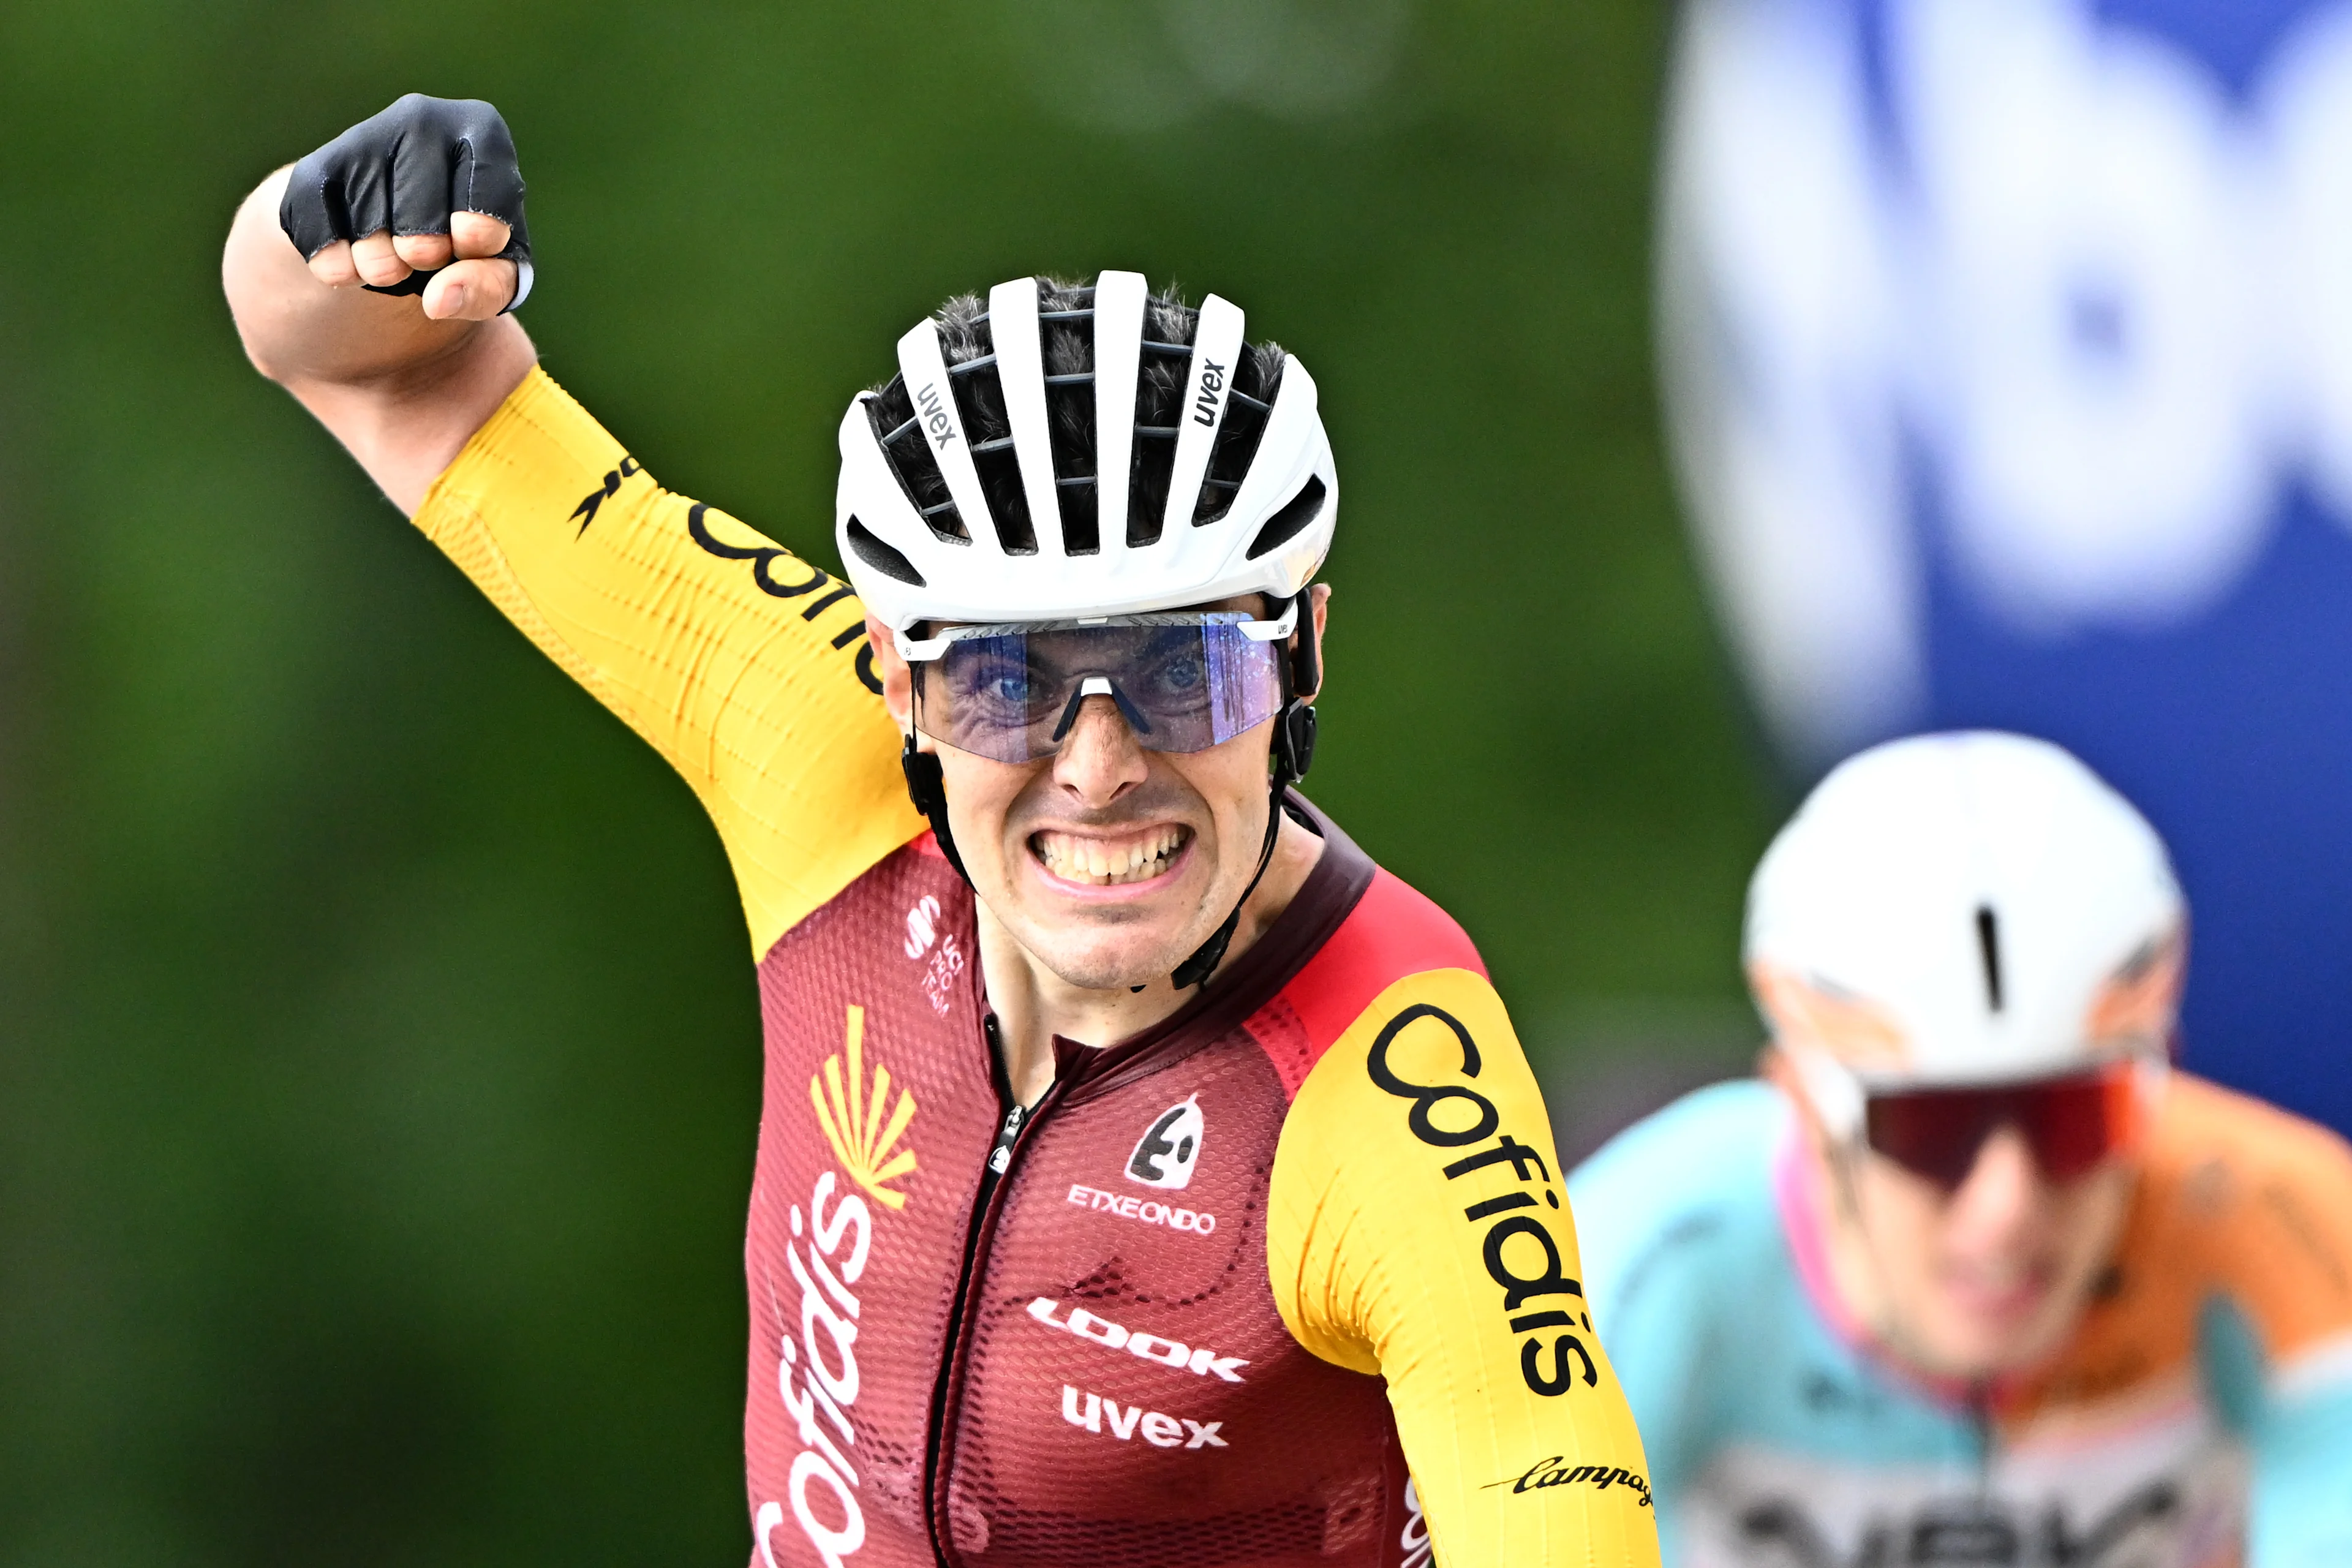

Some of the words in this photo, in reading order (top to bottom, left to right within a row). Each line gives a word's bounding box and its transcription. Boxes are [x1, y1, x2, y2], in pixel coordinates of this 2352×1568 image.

[918, 382, 957, 450] uvex
[1194, 357, 1224, 427] uvex
[688, 503, 884, 696] Cofi
[930, 950, 952, 991] PRO
[943, 933, 964, 975] UCI
[922, 968, 949, 1018] TEAM
[1067, 1184, 1216, 1235] ETXEONDO
[1367, 1003, 1597, 1396] Cofidis
[1027, 1296, 1250, 1382] LOOK
[1062, 1384, 1229, 1448] uvex
[1479, 1455, 1654, 1507] Campag
